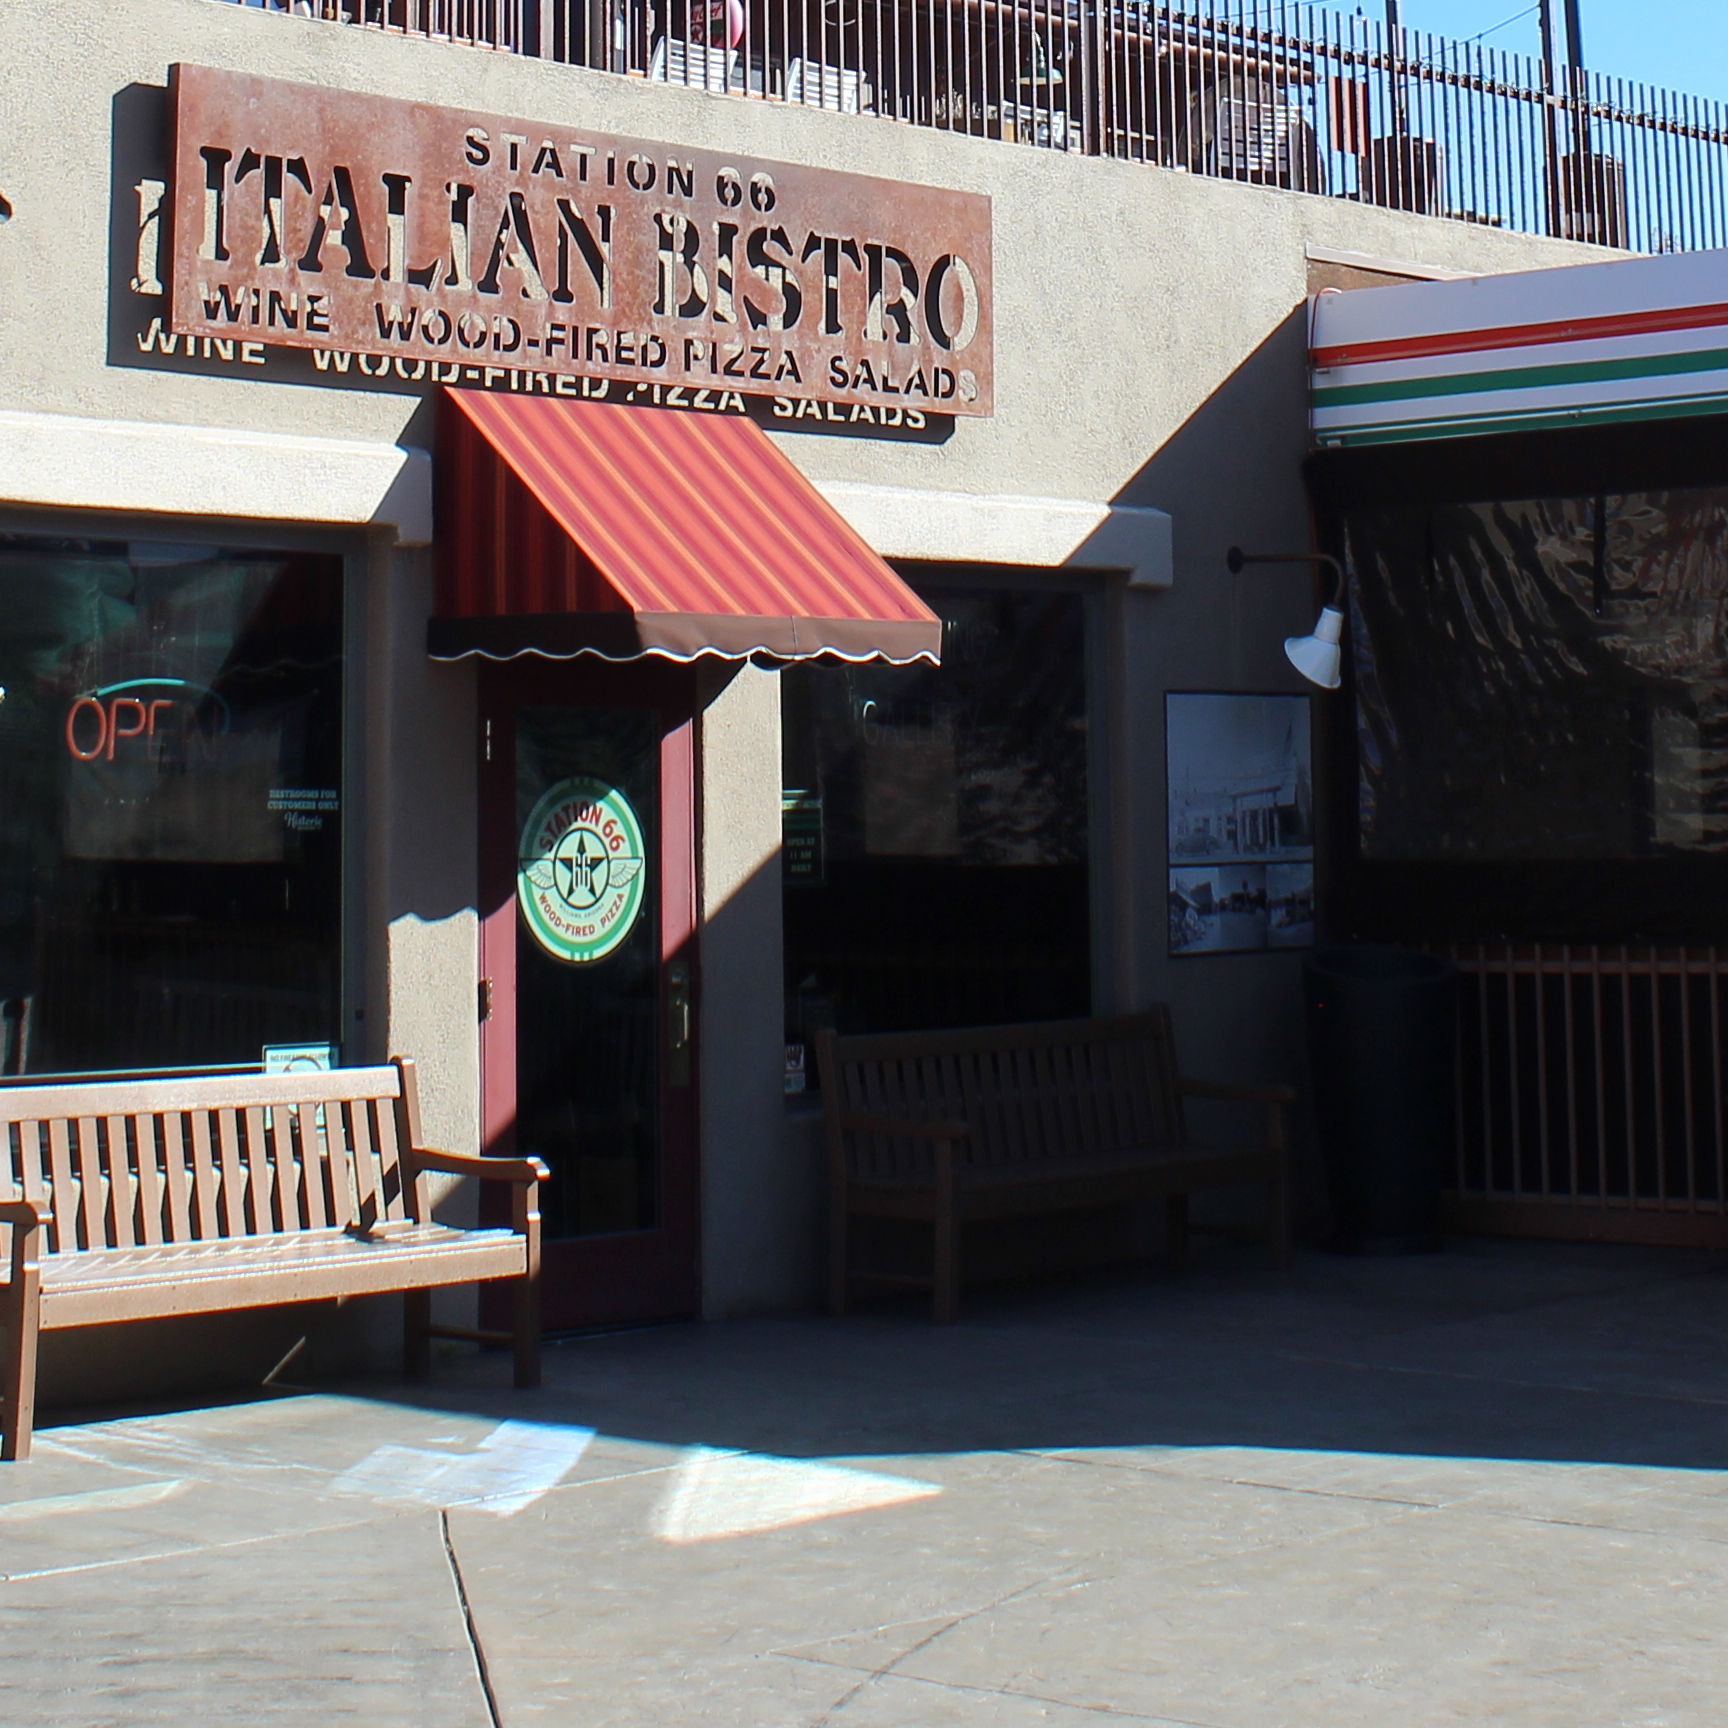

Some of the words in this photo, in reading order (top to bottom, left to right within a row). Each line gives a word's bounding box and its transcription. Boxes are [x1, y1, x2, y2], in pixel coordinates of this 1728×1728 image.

[464, 125, 695, 198] STATION
[714, 165, 778, 213] 66
[196, 144, 613, 309] ITALIAN
[652, 211, 981, 352] BISTRO
[197, 280, 331, 334] WINE
[374, 299, 668, 370] WOOD-FIRED
[682, 336, 802, 384] PIZZA
[829, 353, 980, 404] SALADS
[267, 800, 316, 810] CUSTOMERS
[317, 800, 340, 810] ONLY
[320, 789, 337, 798] FOR
[539, 801, 603, 852] STATION
[602, 819, 625, 851] 66
[538, 891, 596, 937] WOOD-FIRED
[600, 893, 625, 928] PIZZA
